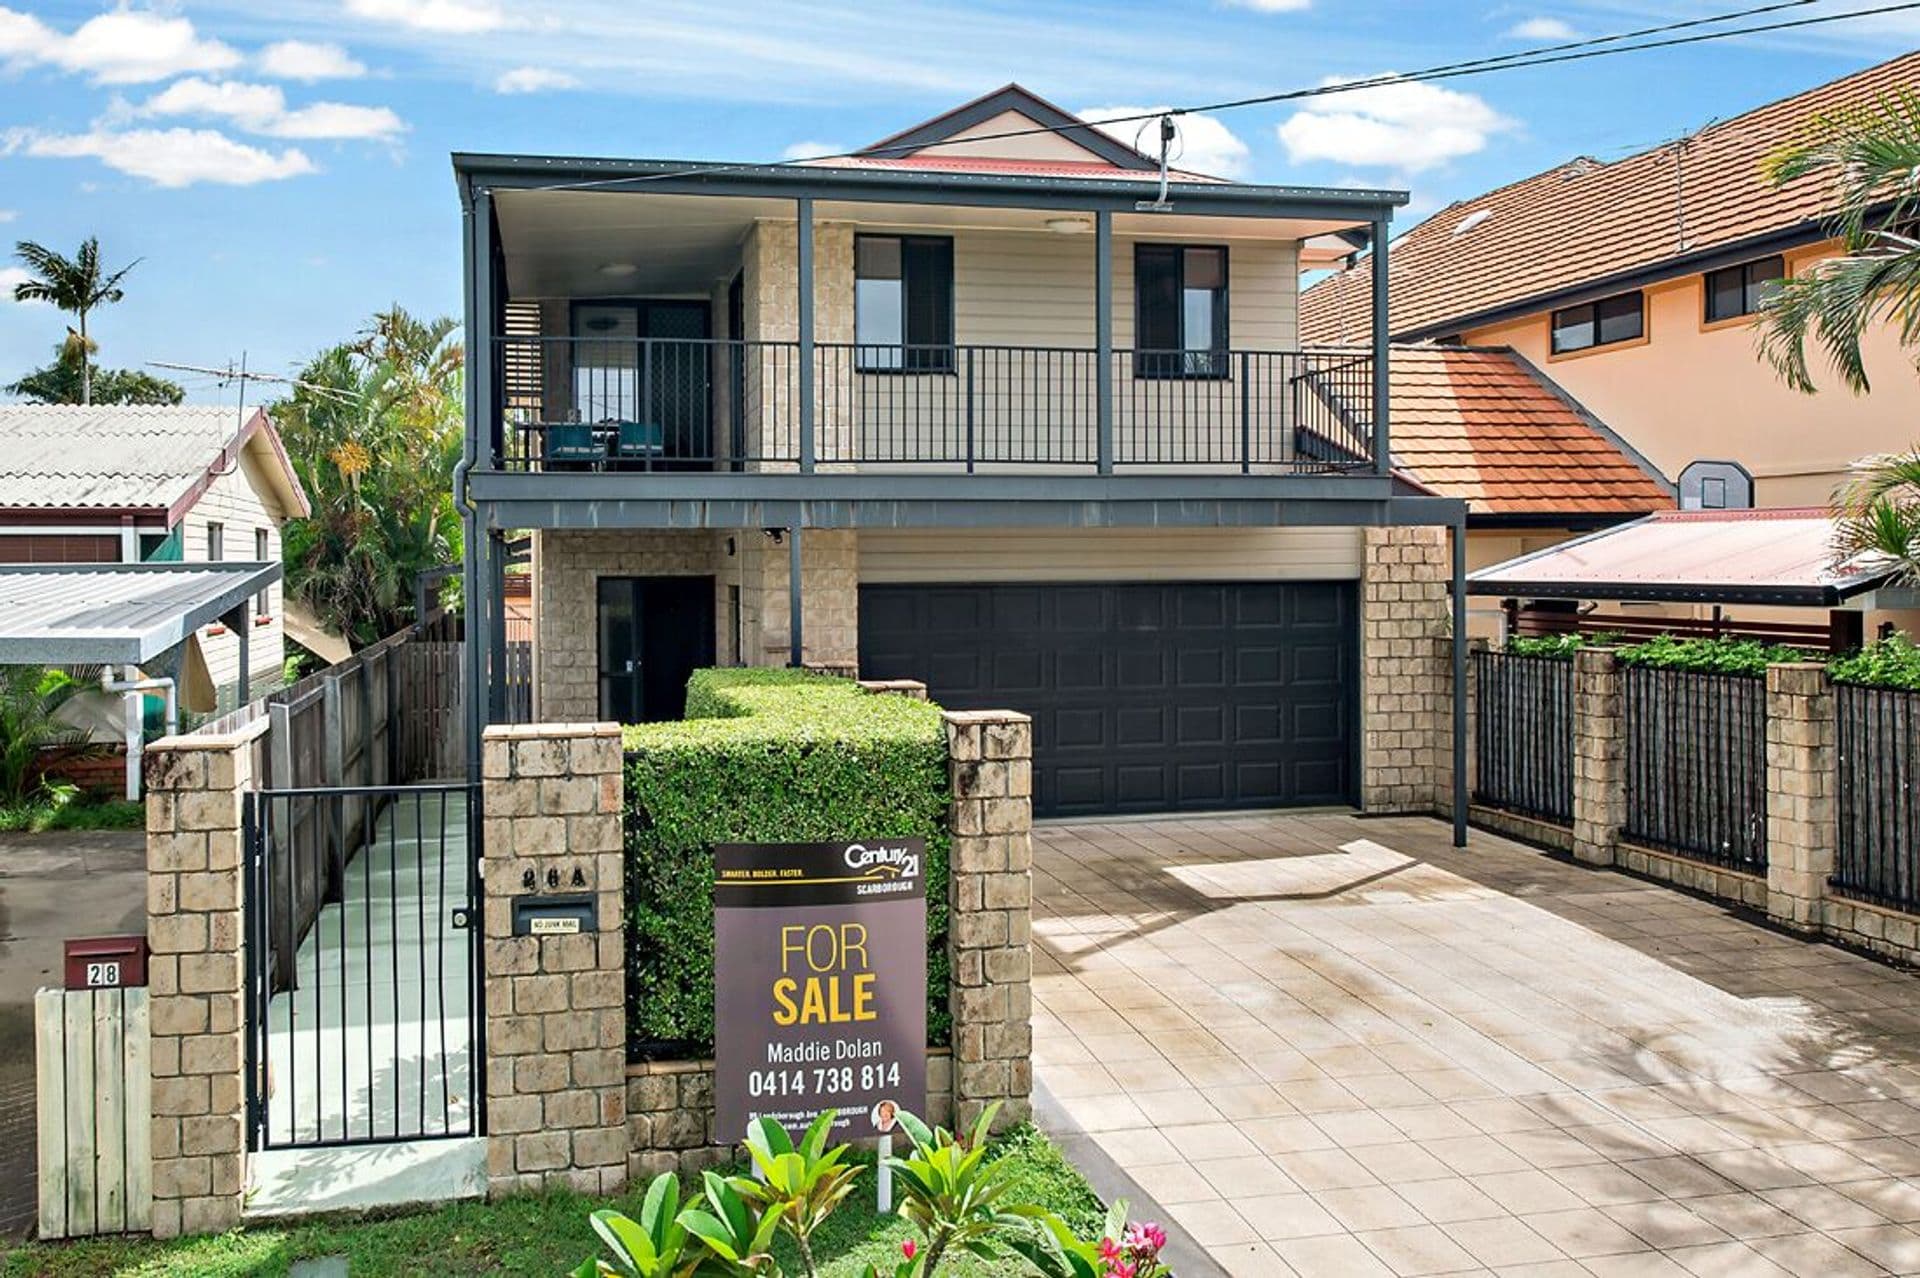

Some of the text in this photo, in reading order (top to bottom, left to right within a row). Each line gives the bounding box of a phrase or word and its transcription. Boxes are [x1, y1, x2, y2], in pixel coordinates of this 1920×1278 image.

[844, 844, 920, 877] Century 21
[856, 881, 913, 896] SCARBOROUGH
[545, 920, 560, 928] JUNK
[562, 919, 577, 928] MAIL
[780, 923, 869, 973] FOR
[90, 965, 116, 984] 28
[772, 973, 877, 1027] SALE
[767, 1039, 883, 1064] Maddie Dolan
[748, 1062, 901, 1097] 0414 738 814
